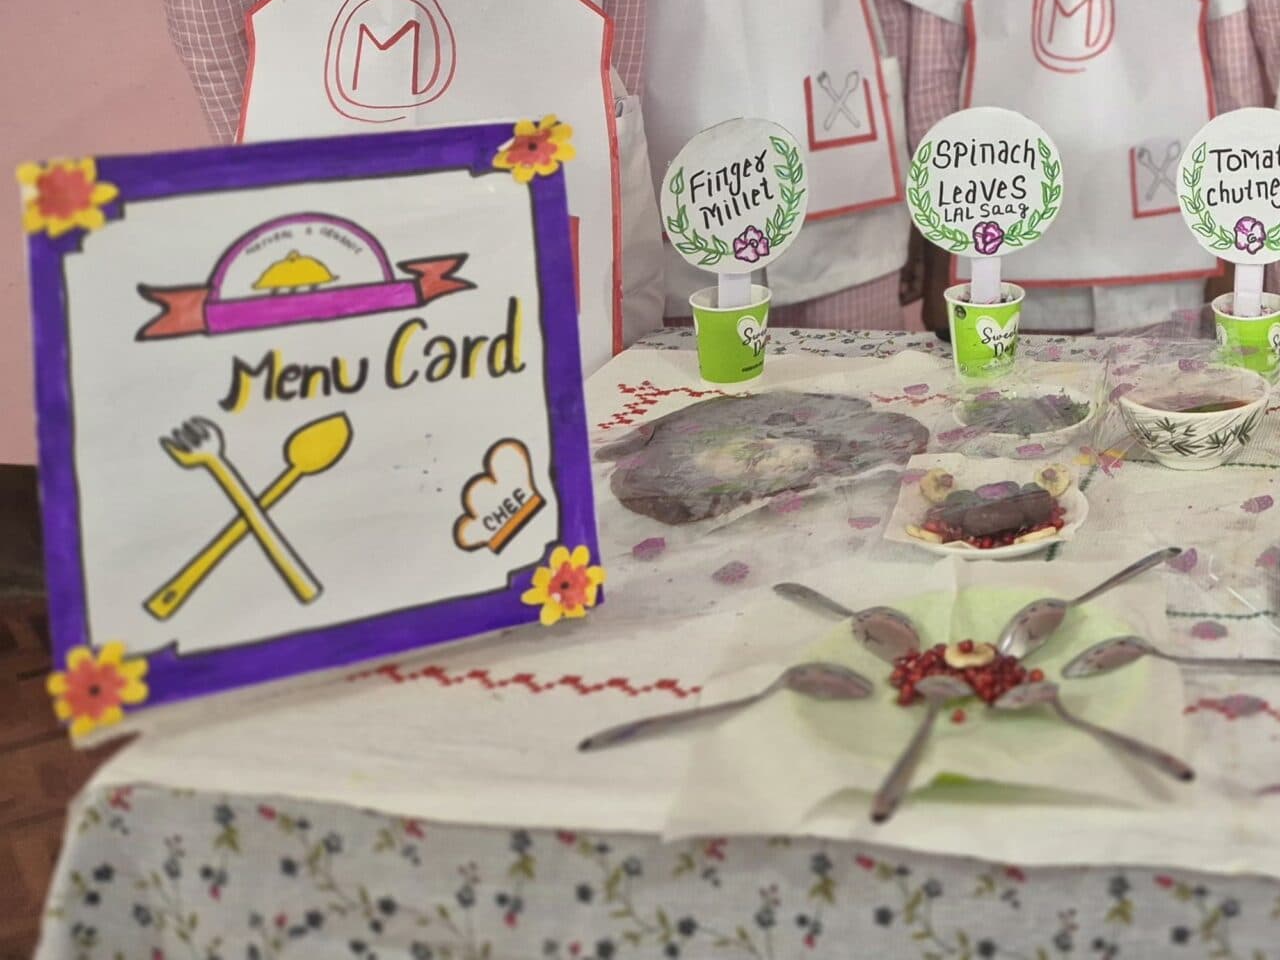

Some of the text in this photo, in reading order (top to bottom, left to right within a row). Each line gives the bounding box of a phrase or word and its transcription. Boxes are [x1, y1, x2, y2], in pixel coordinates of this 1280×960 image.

[690, 149, 768, 204] Finger
[932, 138, 1035, 170] Spinach
[699, 176, 774, 230] Millet
[938, 174, 1028, 208] Leaves
[385, 296, 526, 390] Card
[218, 350, 369, 414] Menu
[482, 488, 528, 532] CHEF
